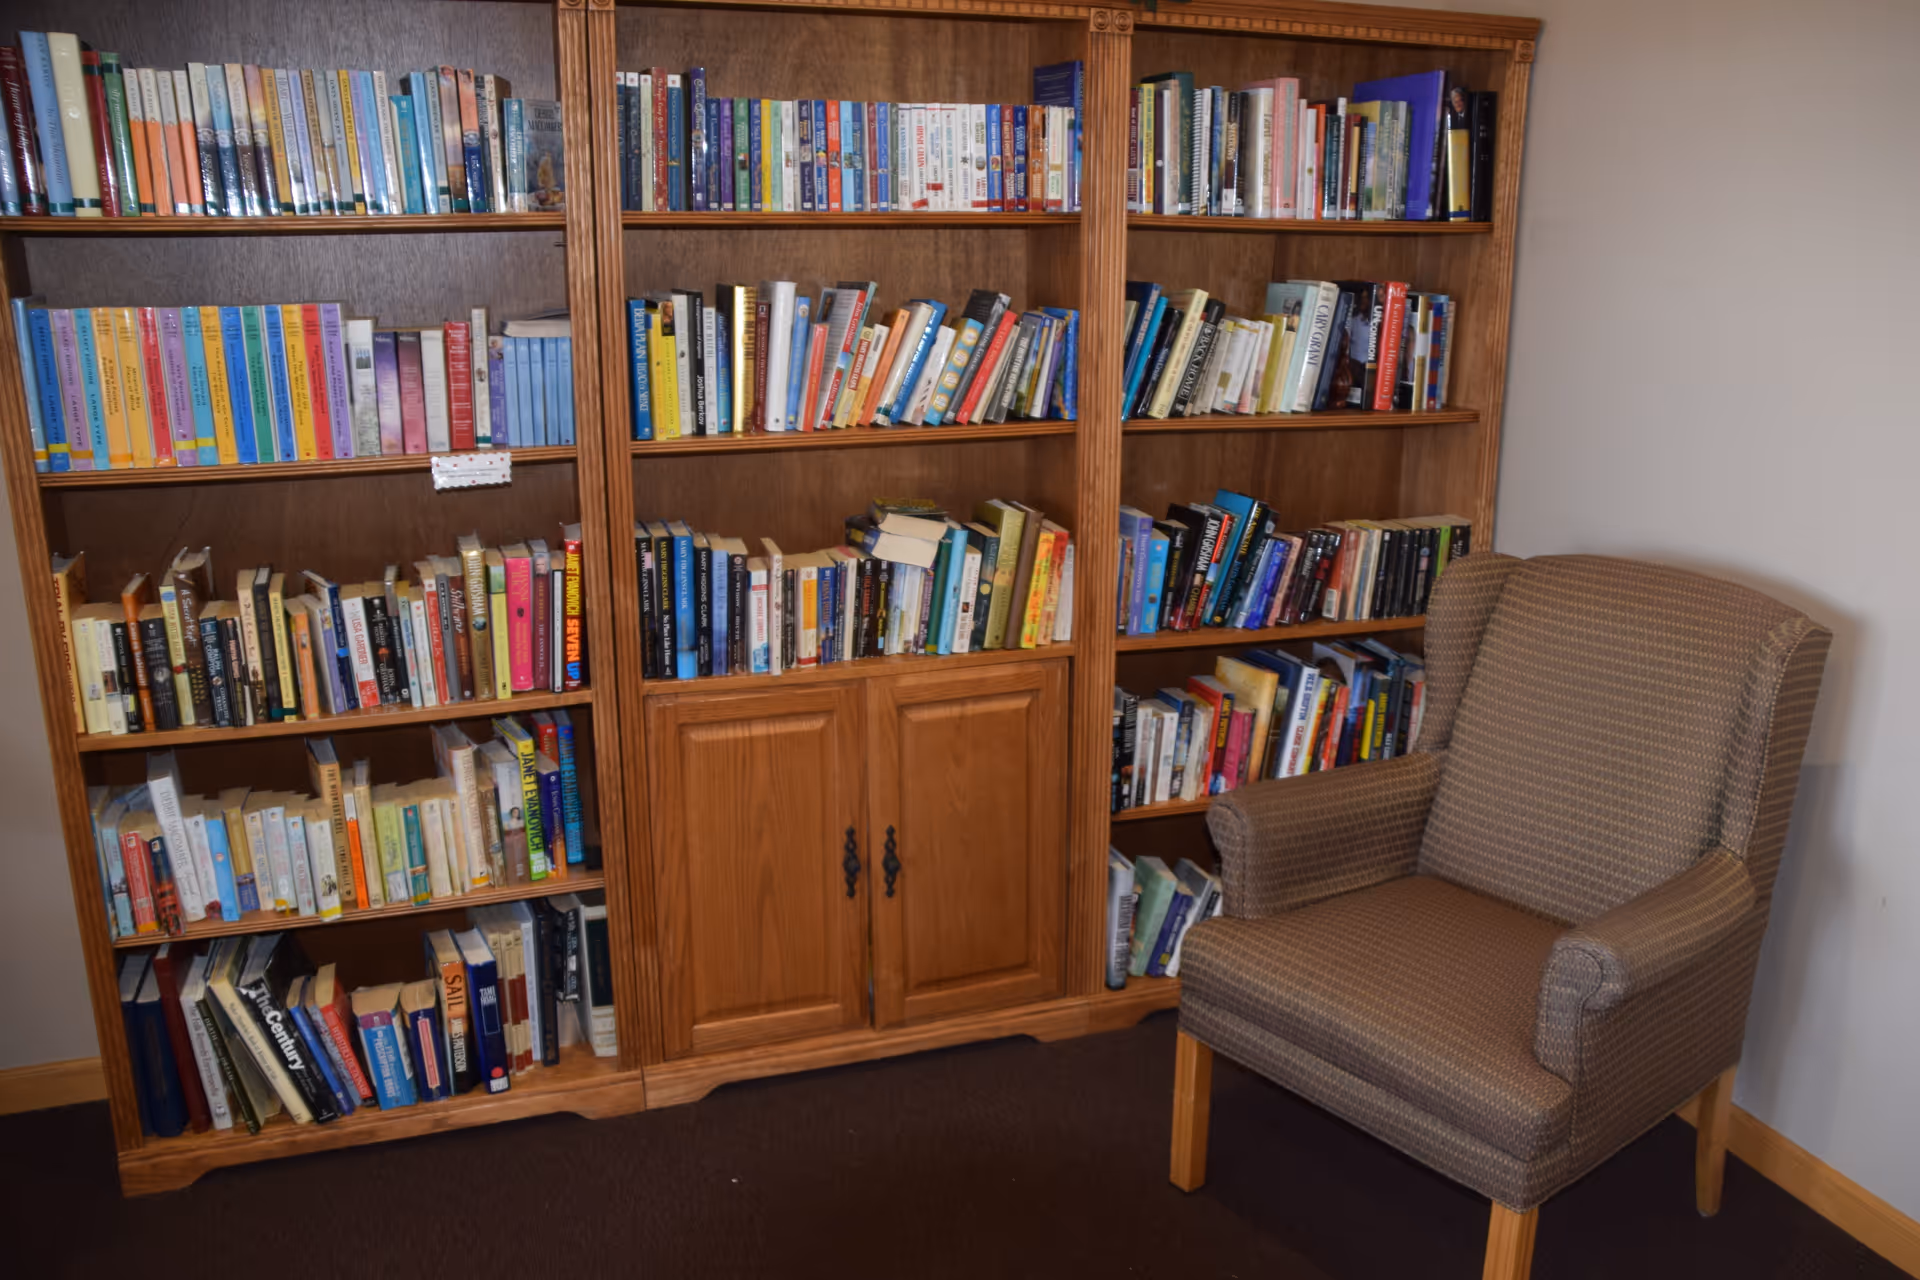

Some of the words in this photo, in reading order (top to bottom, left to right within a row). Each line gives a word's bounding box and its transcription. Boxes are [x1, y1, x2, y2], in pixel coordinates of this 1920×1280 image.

[917, 125, 926, 145] IRISH
[917, 146, 926, 168] CHAIN
[633, 308, 645, 333] BELVA
[853, 301, 863, 317] John
[1314, 304, 1329, 331] CARY
[845, 318, 859, 346] Grisham
[980, 326, 995, 347] Saving
[1367, 305, 1383, 361] UNCOMMON
[1389, 303, 1401, 348] Katharine
[635, 333, 647, 358] PLAIN
[1014, 347, 1027, 362] HUNT
[1019, 336, 1029, 348] THE
[1192, 336, 1212, 362] BACK
[1307, 332, 1323, 367] GRANT
[636, 363, 647, 384] LEGACY
[1008, 373, 1019, 384] RED
[1011, 362, 1022, 373] FOR
[1383, 350, 1396, 393] Hepburn
[696, 374, 704, 399] Joshua
[830, 379, 840, 397] Calico
[849, 372, 859, 389] CLARK
[1180, 364, 1199, 397] HOME
[71, 395, 81, 423] LARGE
[89, 394, 99, 421] LARGE
[94, 424, 102, 446] TYPE
[697, 400, 705, 425] Berkov
[75, 427, 83, 447] TYPE
[1205, 518, 1220, 538] JOHN
[680, 539, 688, 559] MARY
[1196, 539, 1217, 571] GRISHAM
[566, 552, 579, 575] JANET
[680, 560, 688, 587] HIGGINS
[469, 578, 486, 615] GRISHAM
[566, 575, 579, 616] EVANOVICH
[642, 589, 650, 613] CLARK
[182, 598, 194, 623] Secret
[450, 588, 464, 634] Stillwater
[662, 614, 670, 623] No
[184, 625, 196, 645] Kept
[351, 618, 363, 633] LISA
[663, 623, 671, 637] Place
[355, 634, 369, 665] GARDNER
[566, 618, 580, 662] SEVEN
[205, 644, 215, 676] COMPTON
[212, 648, 221, 670] RALPH
[566, 662, 580, 680] UP
[379, 663, 389, 692] GRISHAM
[558, 736, 575, 767] JANET
[520, 751, 535, 787] JANET
[330, 784, 342, 817] MIDNIGHT
[562, 769, 580, 825] EVANOVICH
[159, 790, 176, 818] DEBBIE
[168, 819, 187, 868] MACOMBER
[524, 788, 542, 852] EVANOVICH
[444, 974, 464, 1011] SAIL
[192, 1017, 203, 1032] Folk
[252, 982, 274, 1014] The
[266, 1010, 305, 1071] Century
[450, 1017, 463, 1038] JAMES
[452, 1038, 467, 1073] PATTERSON
